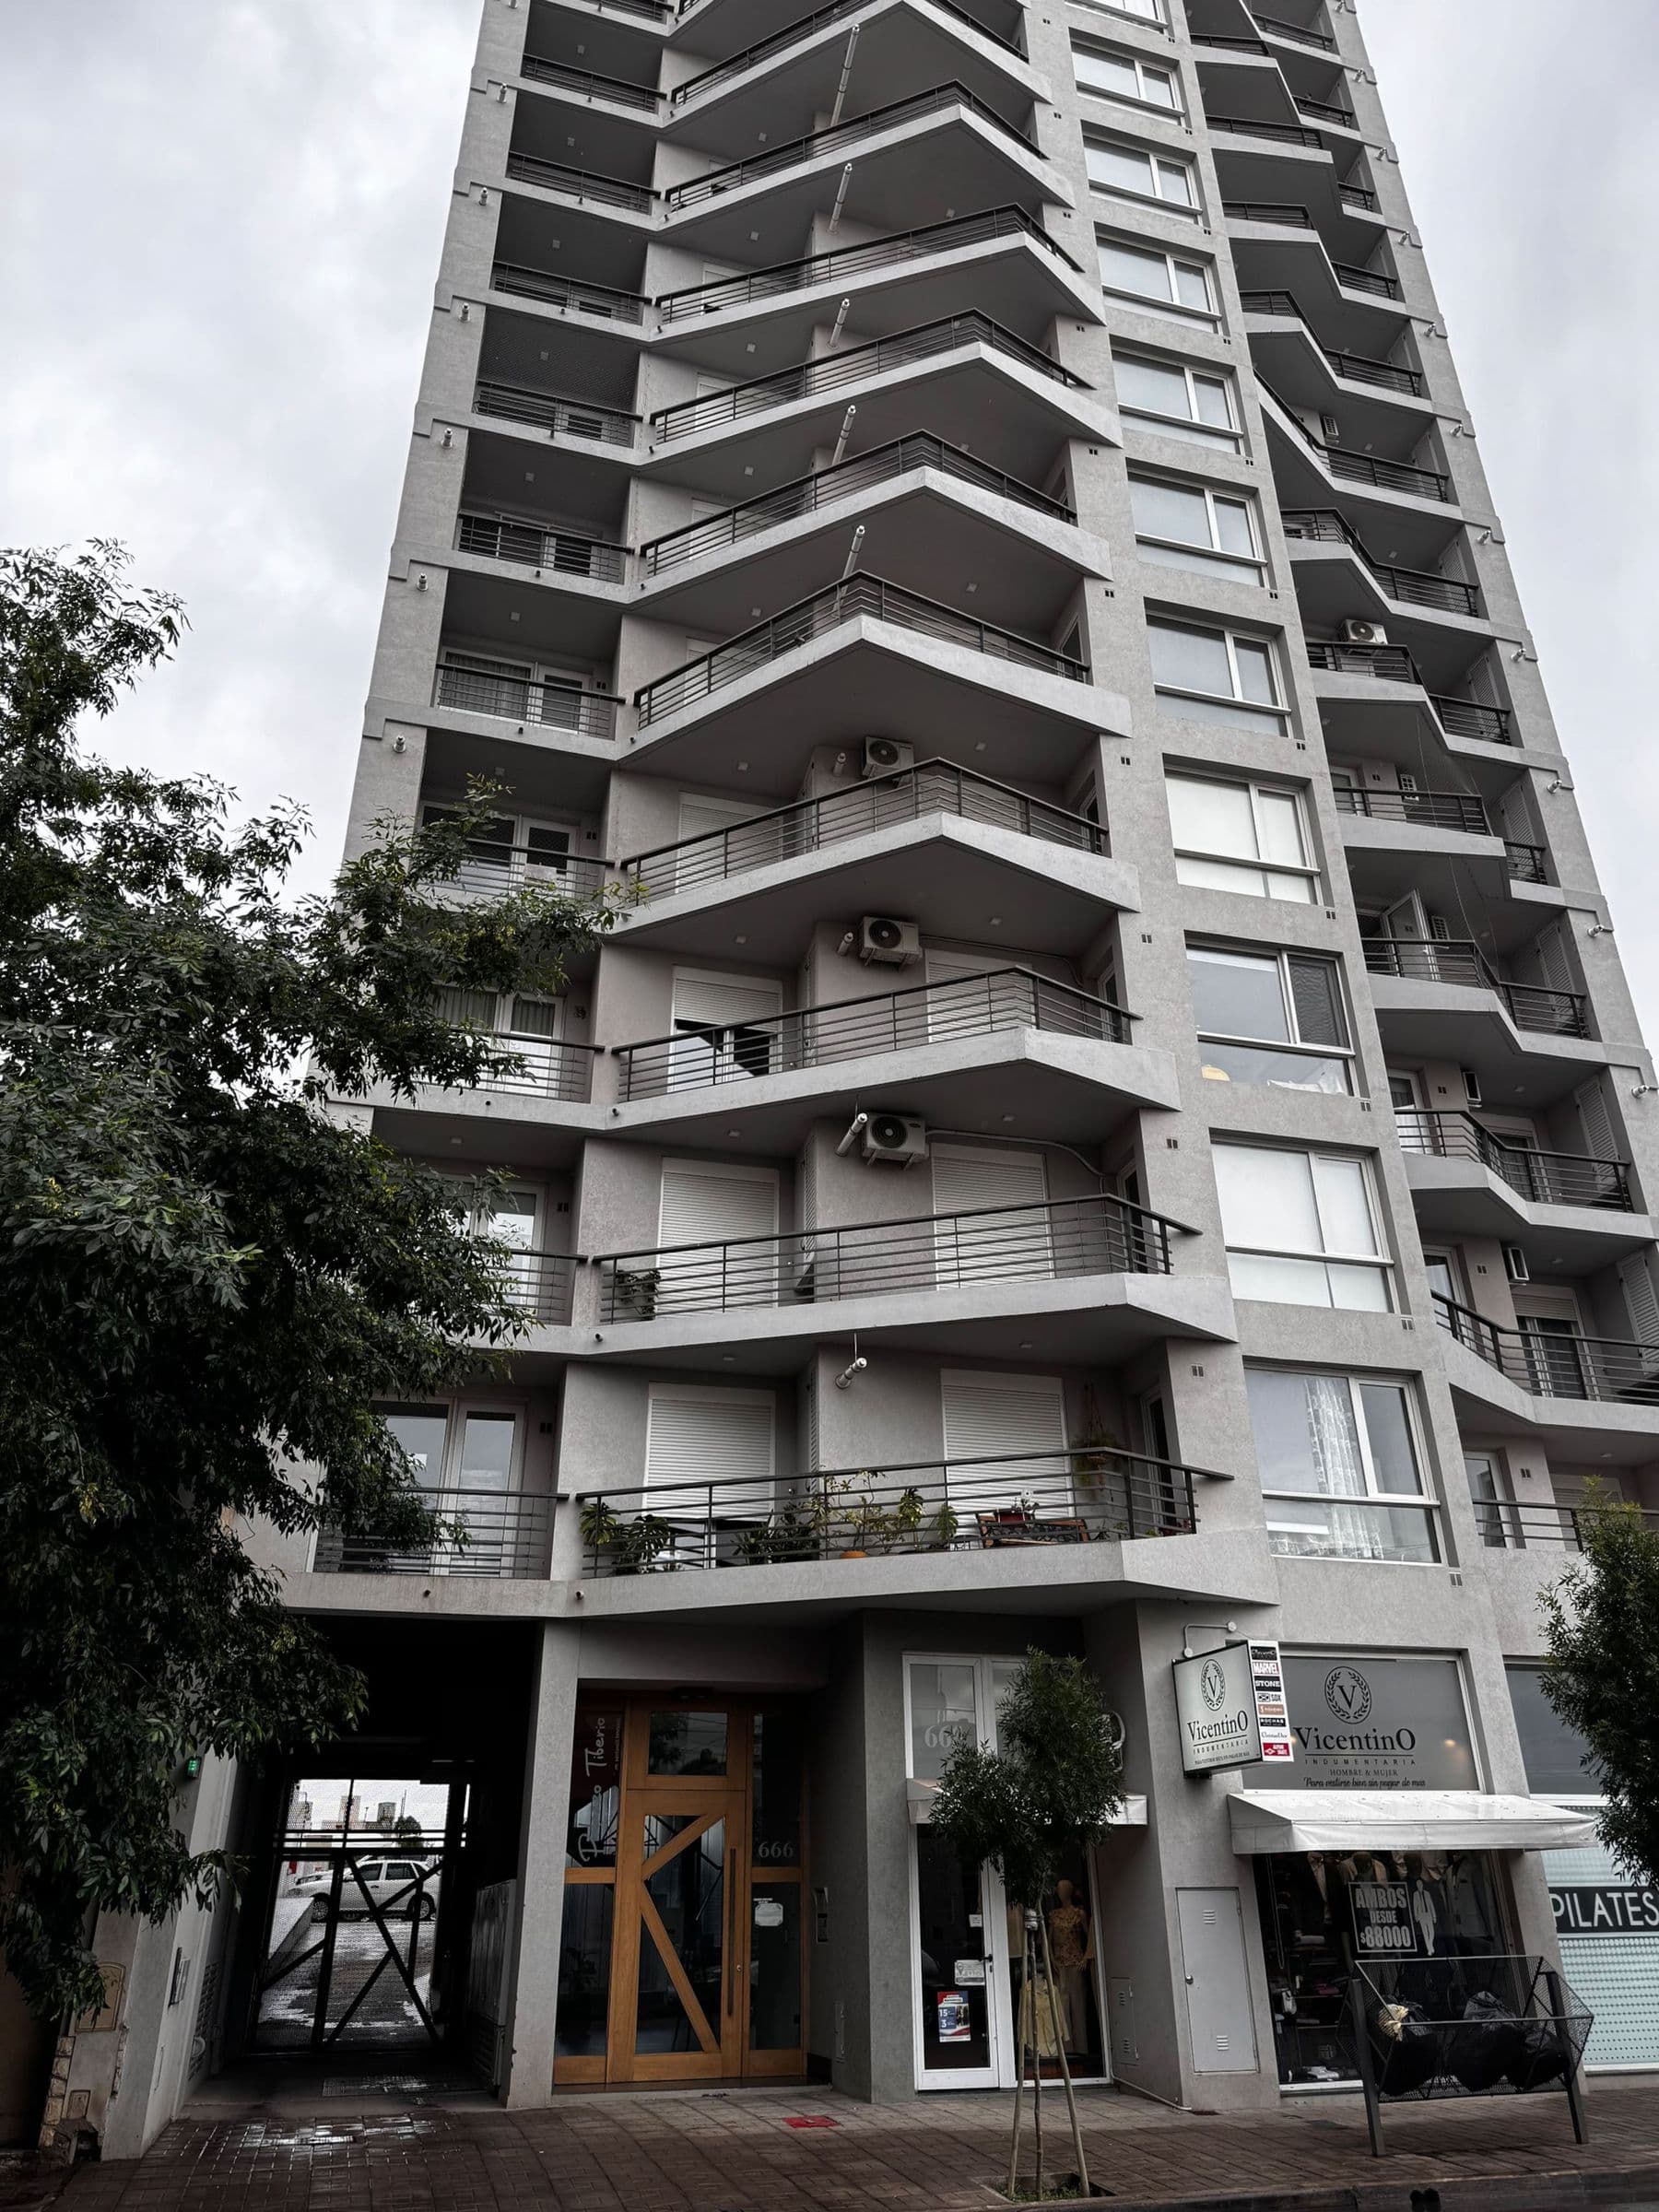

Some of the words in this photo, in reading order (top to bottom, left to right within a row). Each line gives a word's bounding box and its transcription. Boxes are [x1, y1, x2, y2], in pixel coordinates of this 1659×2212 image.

[1207, 1675, 1218, 1697] V
[1336, 1685, 1358, 1709] V
[1187, 1711, 1248, 1741] VicentinO
[585, 1718, 607, 1777] Tiberio
[1293, 1727, 1416, 1751] VicentinO
[1303, 1777, 1324, 1786] Para
[1373, 1769, 1398, 1777] MUJER
[759, 1841, 793, 1858] 666
[1355, 1888, 1407, 1909] AMBOS
[1548, 1891, 1659, 1927] PILATES
[1370, 1911, 1398, 1924] DESDE
[1360, 1925, 1411, 1947] $88000
